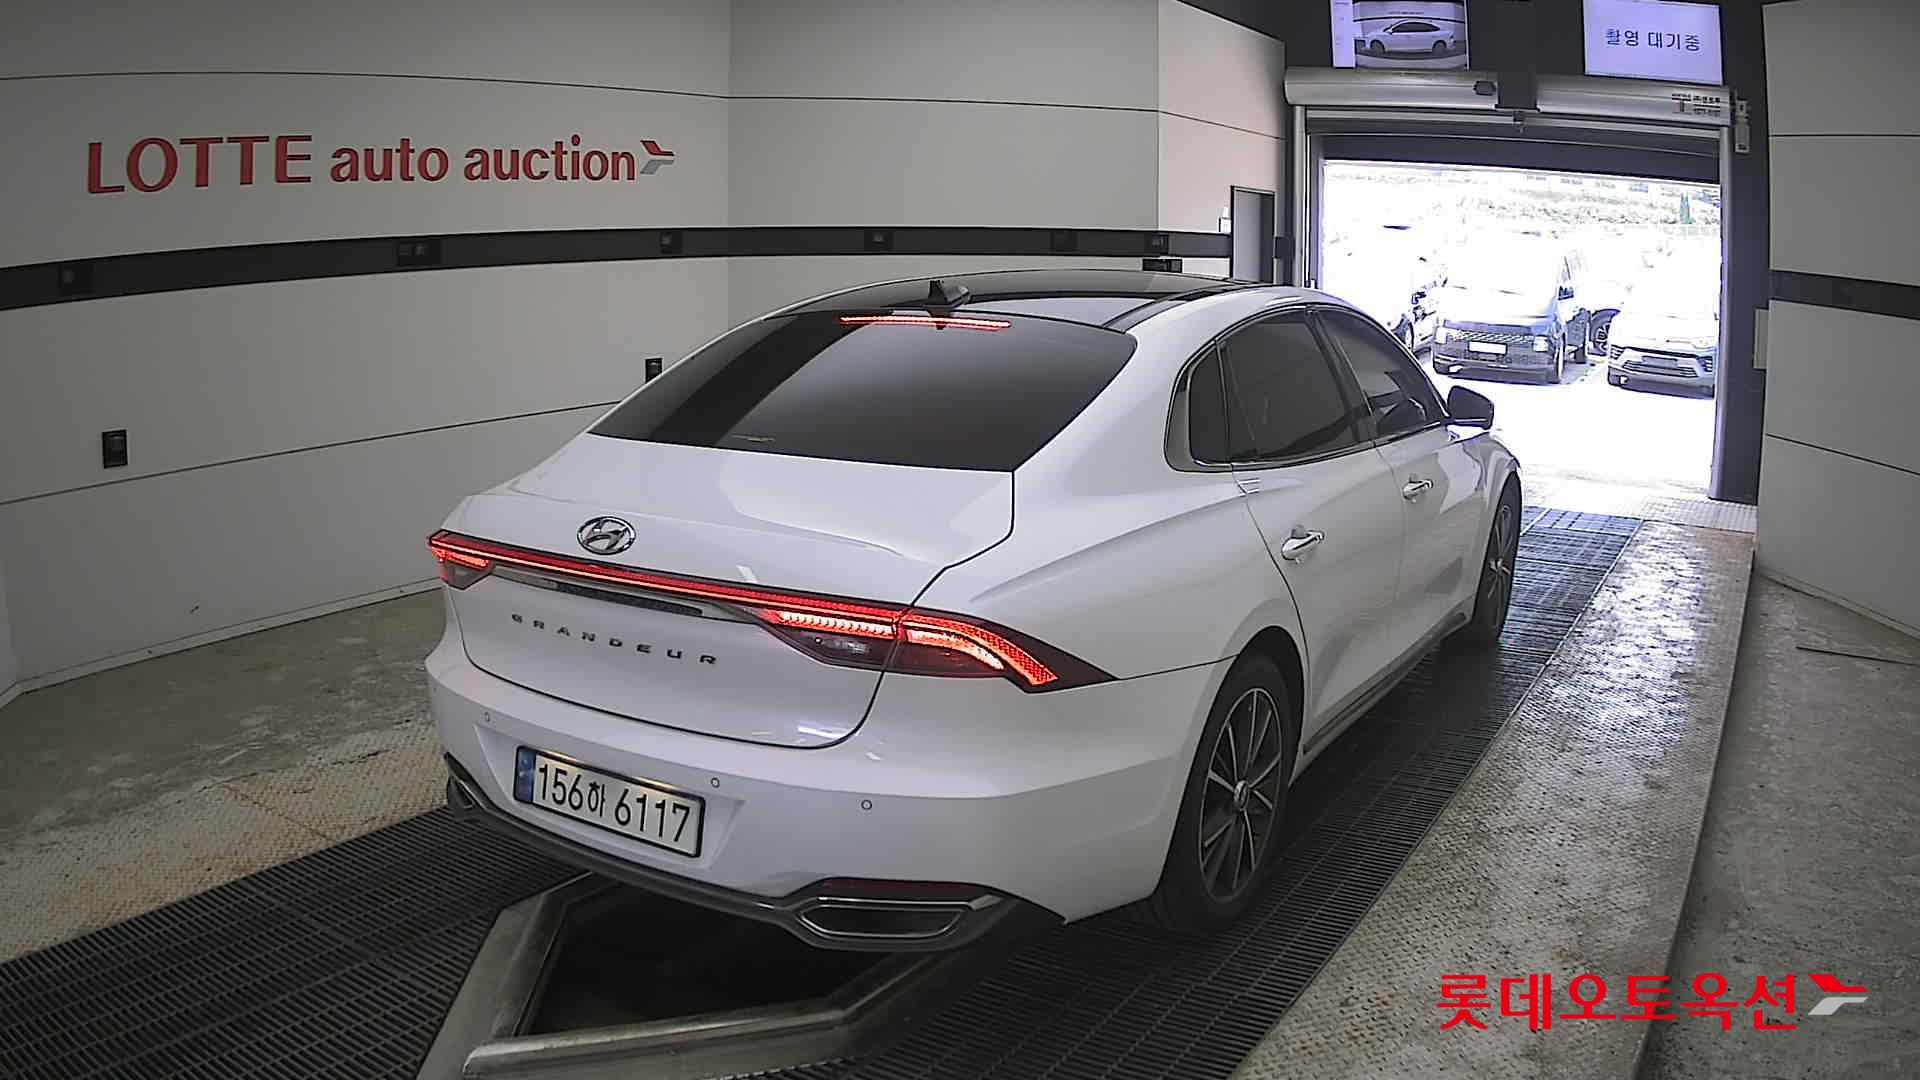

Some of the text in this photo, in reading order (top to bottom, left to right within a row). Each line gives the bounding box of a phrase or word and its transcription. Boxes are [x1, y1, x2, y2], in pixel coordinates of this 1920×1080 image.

[1605, 29, 1700, 52] 촬영 대기중
[87, 134, 637, 194] LOTTE auto auction
[511, 613, 717, 665] GRANDEUR
[539, 763, 691, 843] 156하 6117
